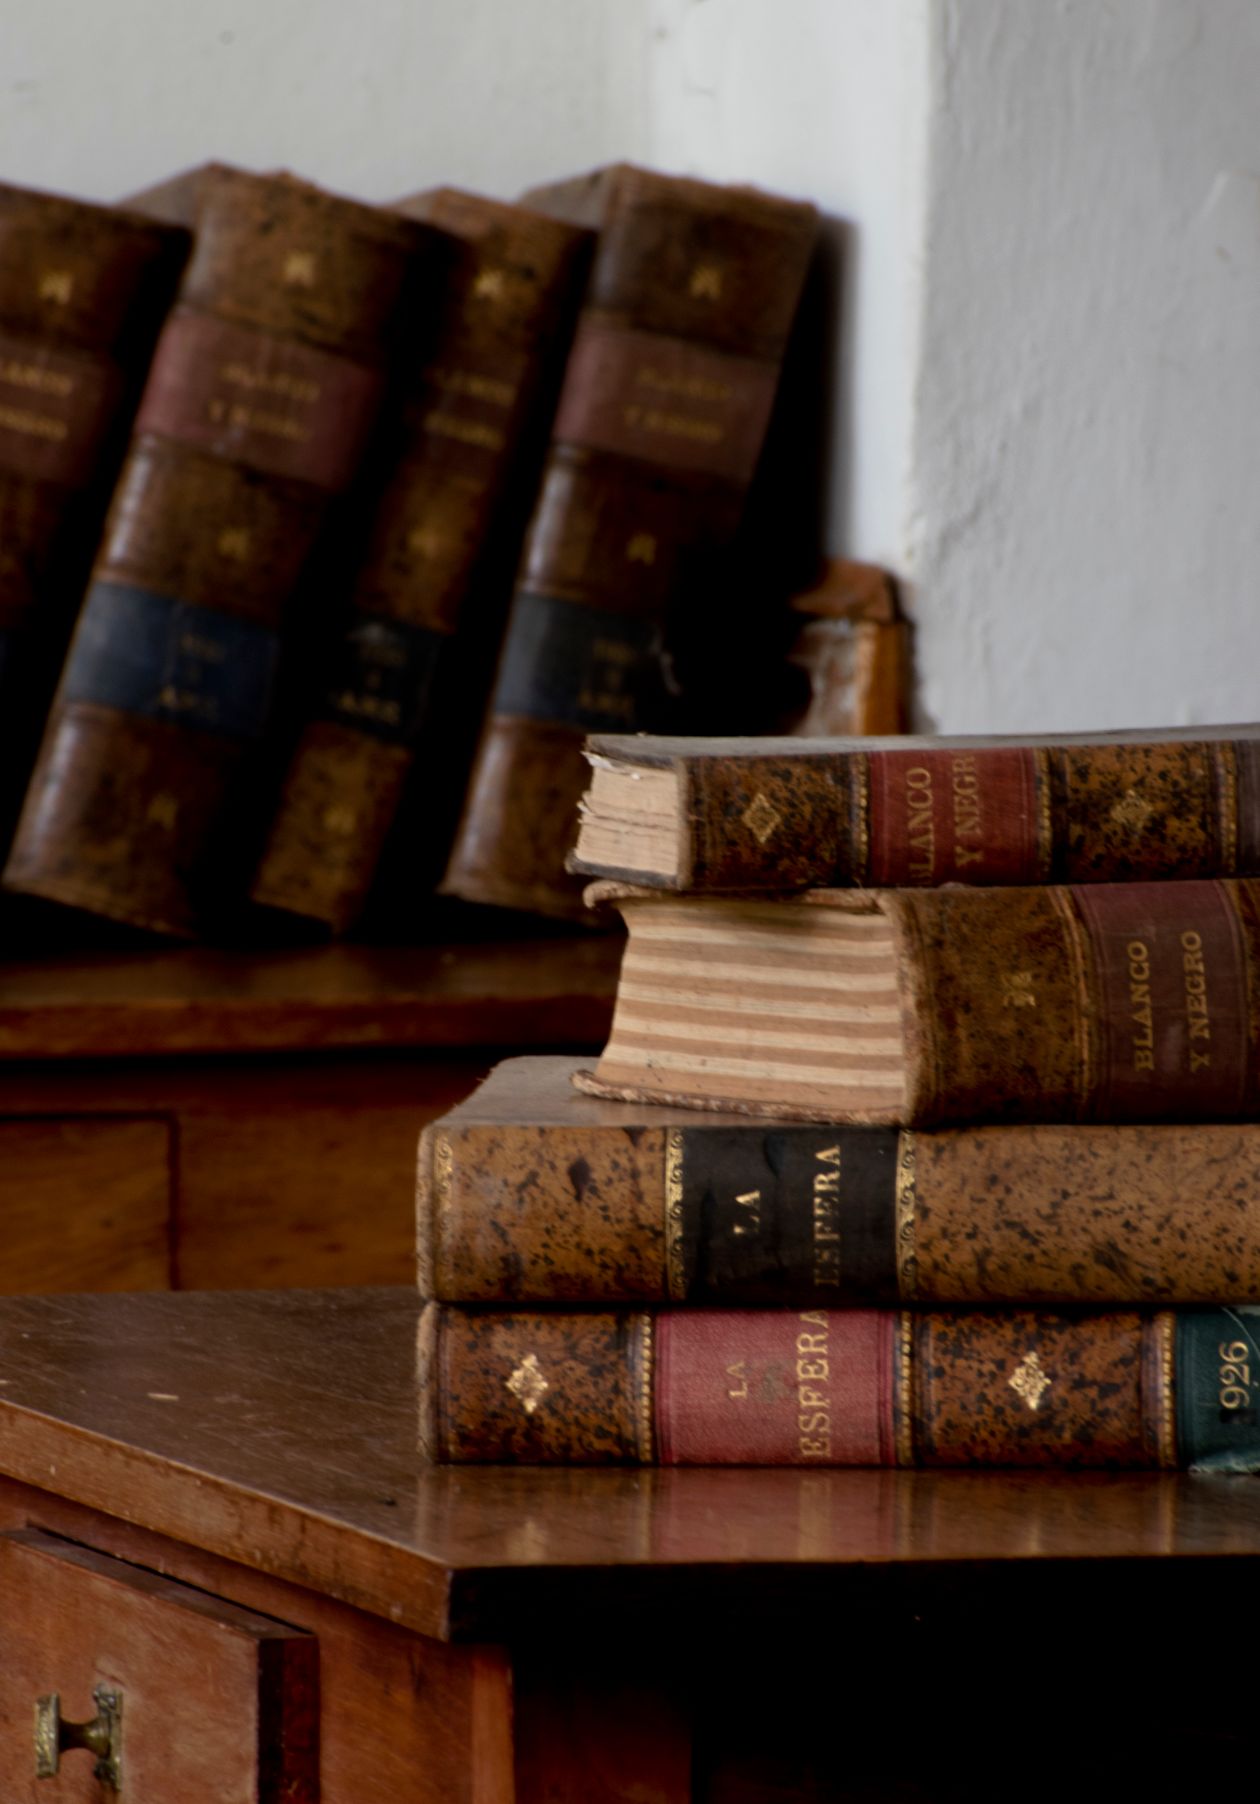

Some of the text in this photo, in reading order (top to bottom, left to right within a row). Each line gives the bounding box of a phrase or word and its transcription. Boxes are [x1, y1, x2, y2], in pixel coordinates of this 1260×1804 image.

[953, 755, 984, 868] Y NEGR
[1127, 941, 1154, 1071] BLANCO
[1181, 932, 1210, 1073] Y NEGRO
[726, 1362, 748, 1399] LA
[797, 1310, 831, 1457] ESFERA
